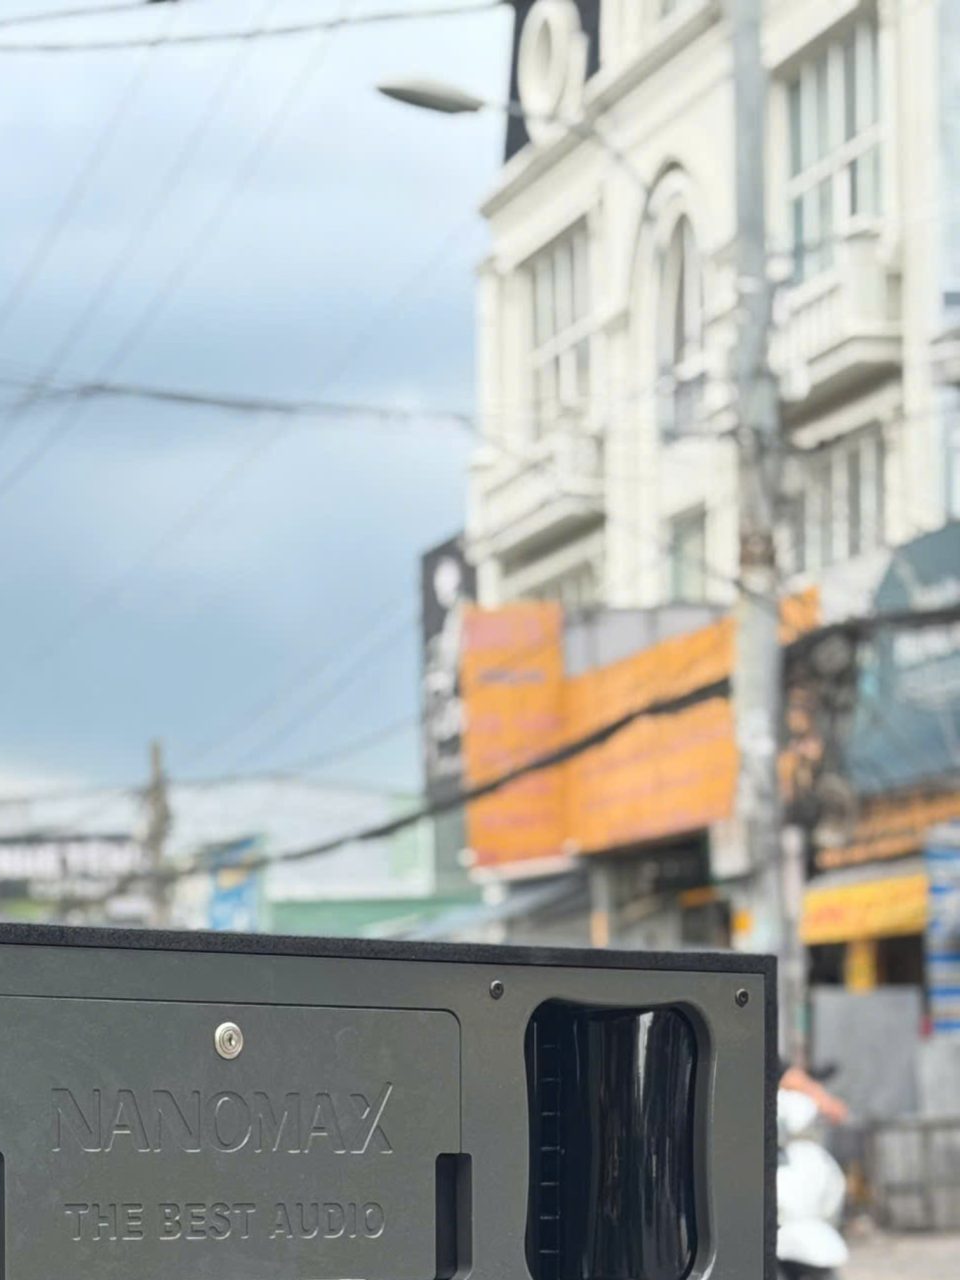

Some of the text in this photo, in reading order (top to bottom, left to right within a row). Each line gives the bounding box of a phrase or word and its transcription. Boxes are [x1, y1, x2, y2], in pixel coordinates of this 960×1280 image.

[51, 1081, 394, 1154] NANOMAX
[64, 1202, 385, 1241] THE BEST AUDIO
